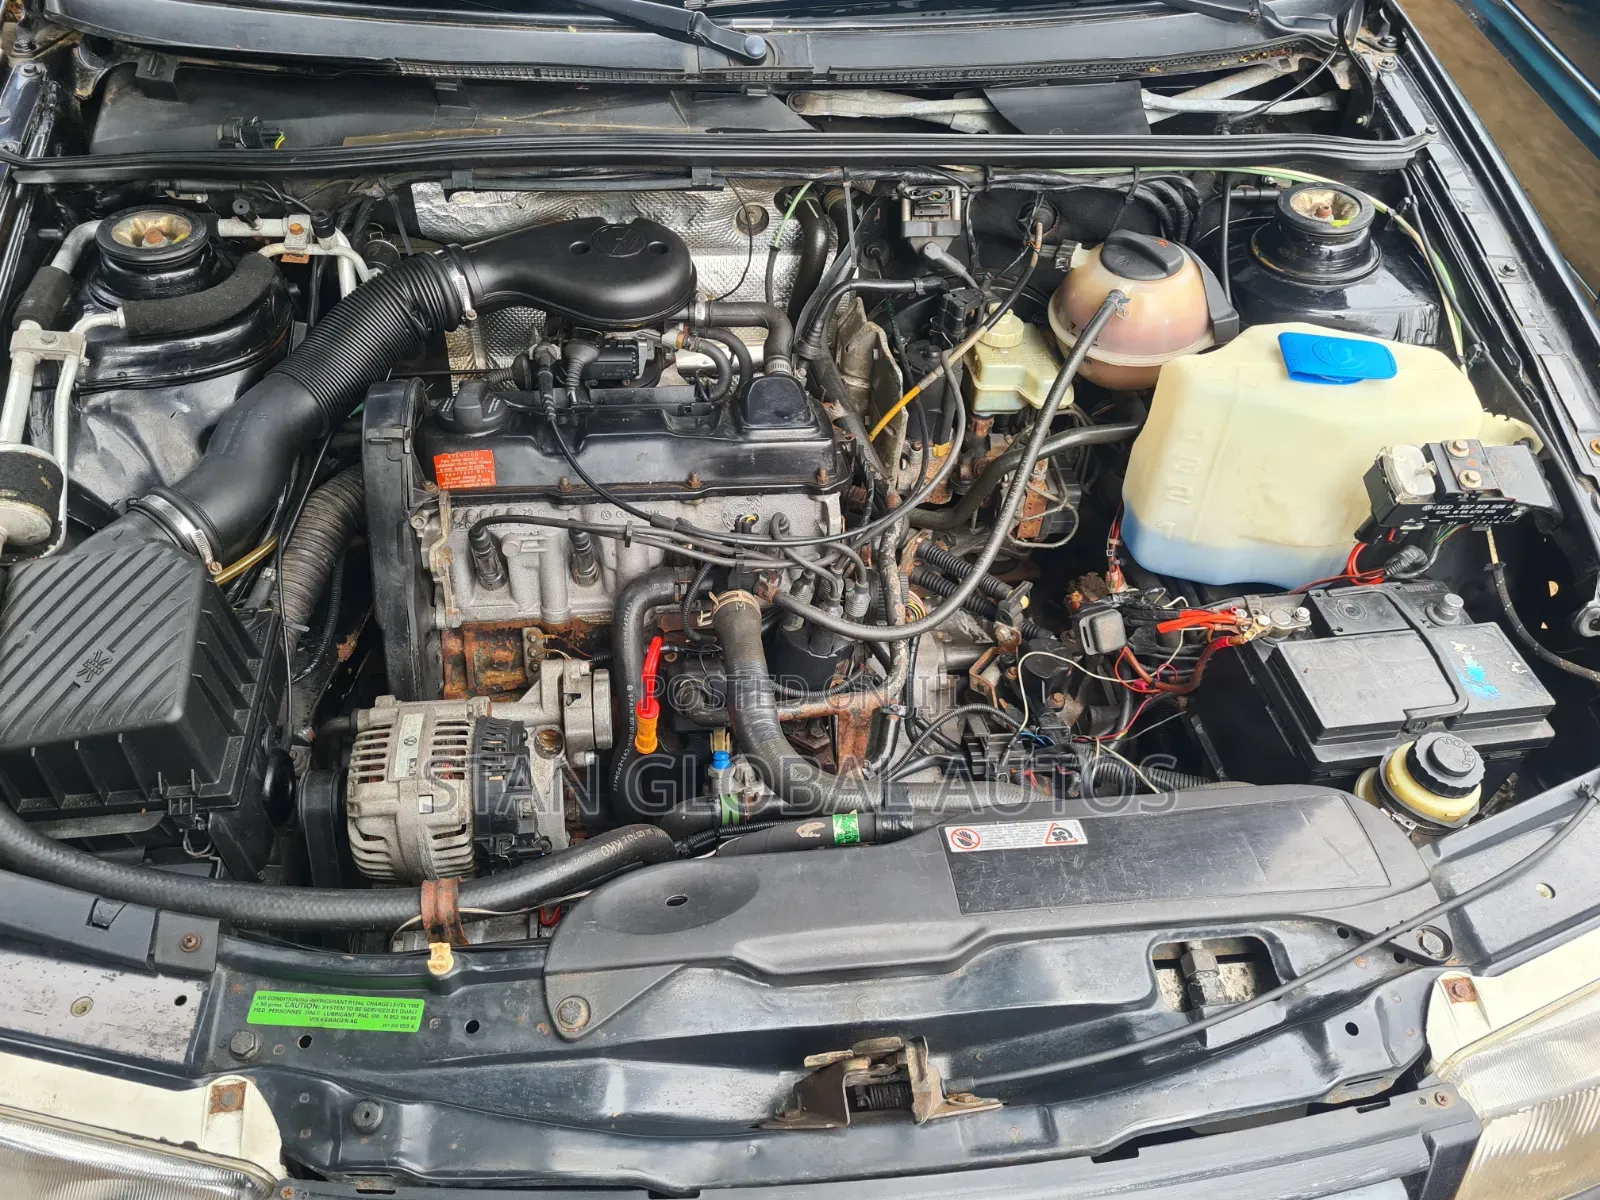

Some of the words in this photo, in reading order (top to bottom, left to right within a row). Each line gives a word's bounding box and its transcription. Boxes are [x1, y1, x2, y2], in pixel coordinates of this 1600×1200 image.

[600, 839, 624, 857] KKO
[267, 995, 308, 1003] CONDITIONING
[309, 1016, 348, 1024] VOLKSWAGEN
